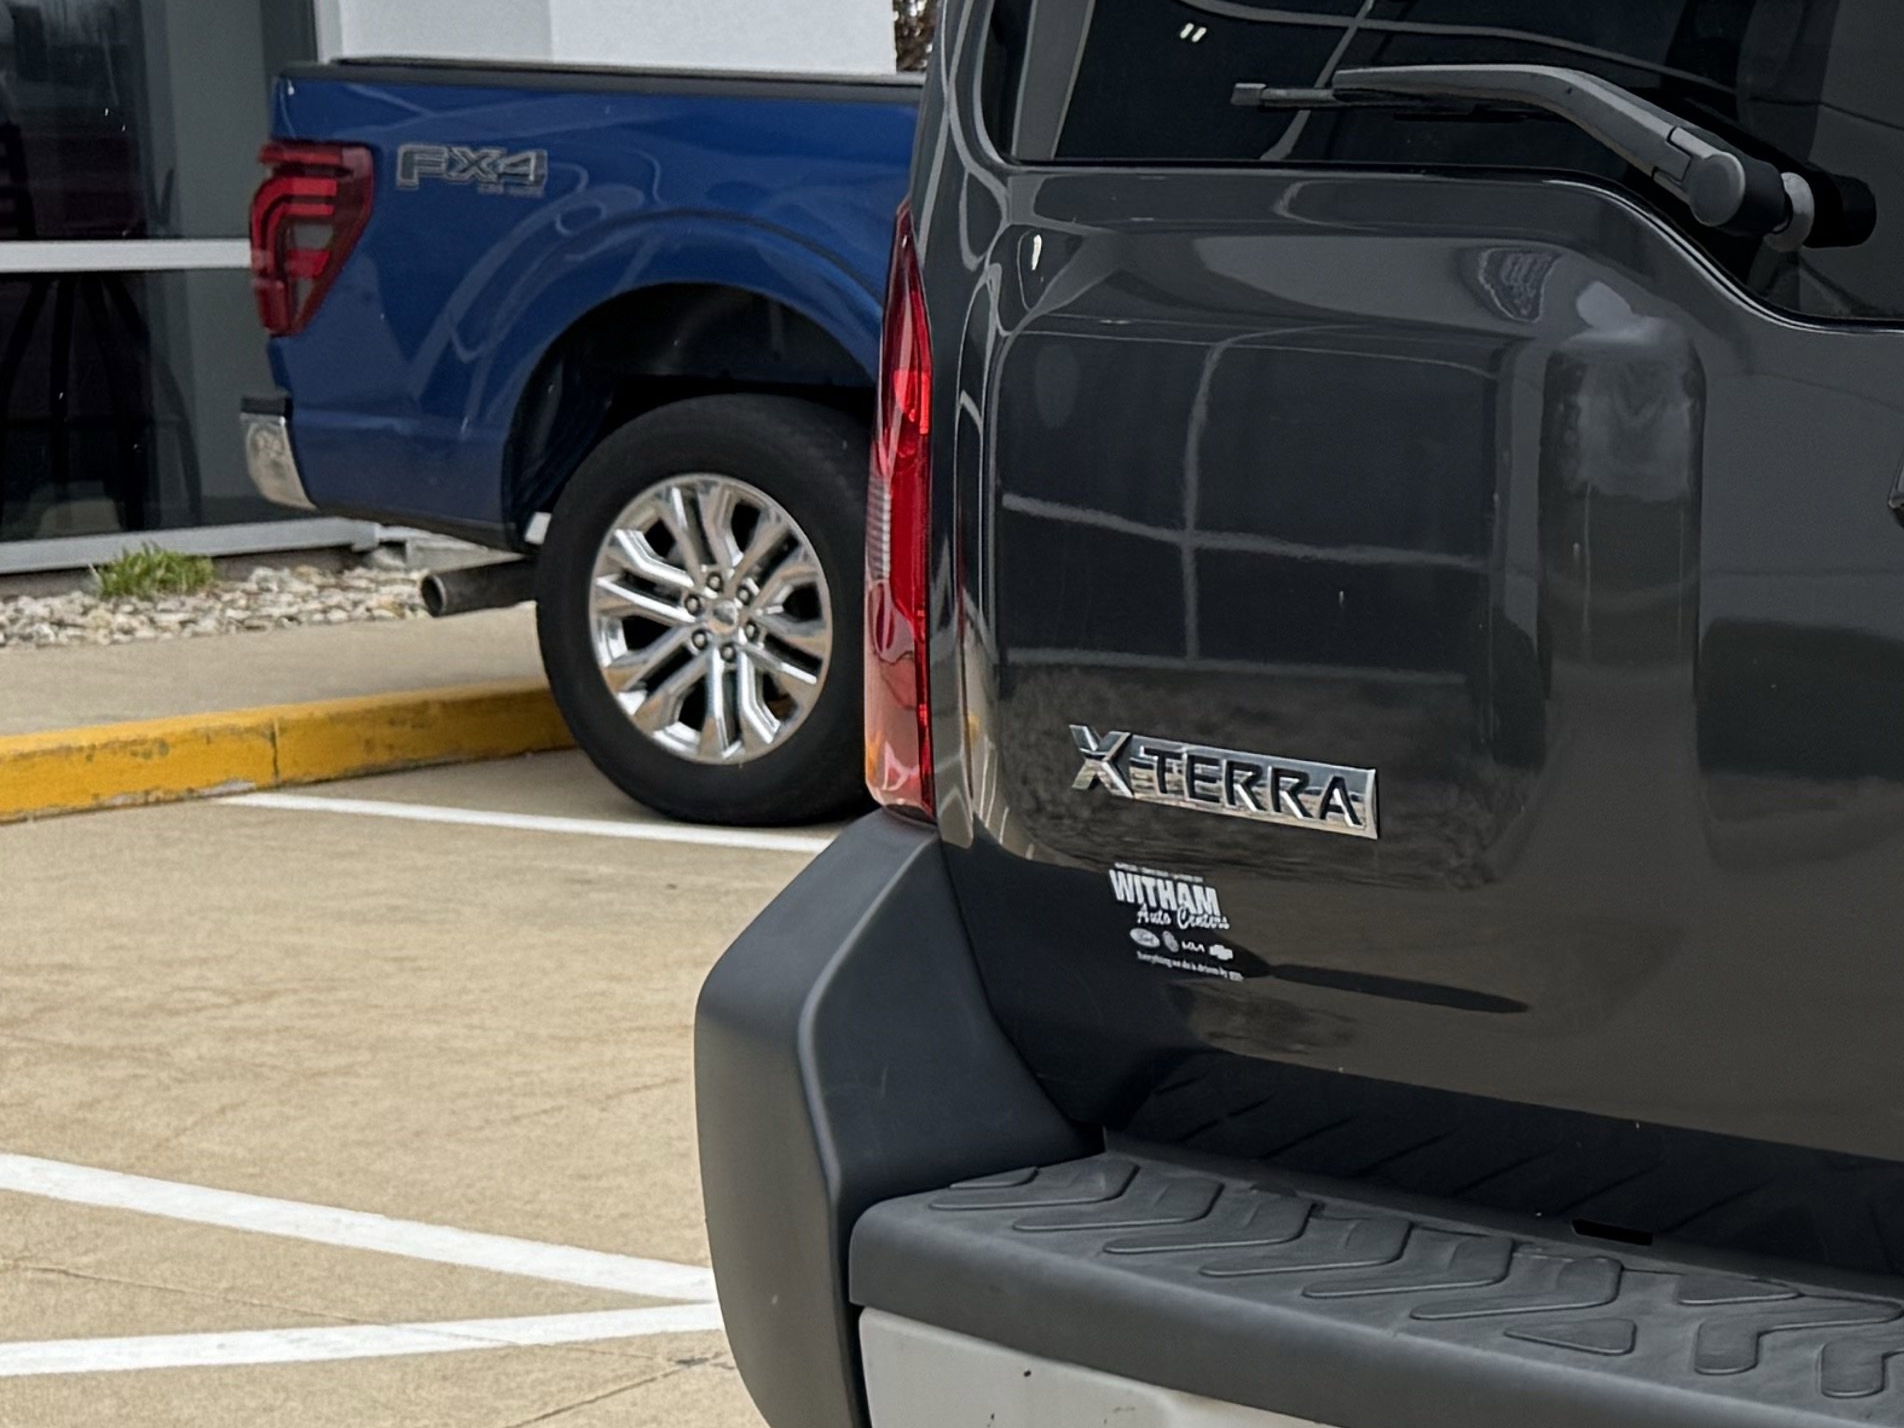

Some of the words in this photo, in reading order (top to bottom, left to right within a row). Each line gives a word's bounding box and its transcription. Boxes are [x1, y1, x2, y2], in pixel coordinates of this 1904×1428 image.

[397, 144, 548, 190] FX4
[1069, 724, 1376, 839] XTERRA
[1109, 869, 1221, 916] WITHAM
